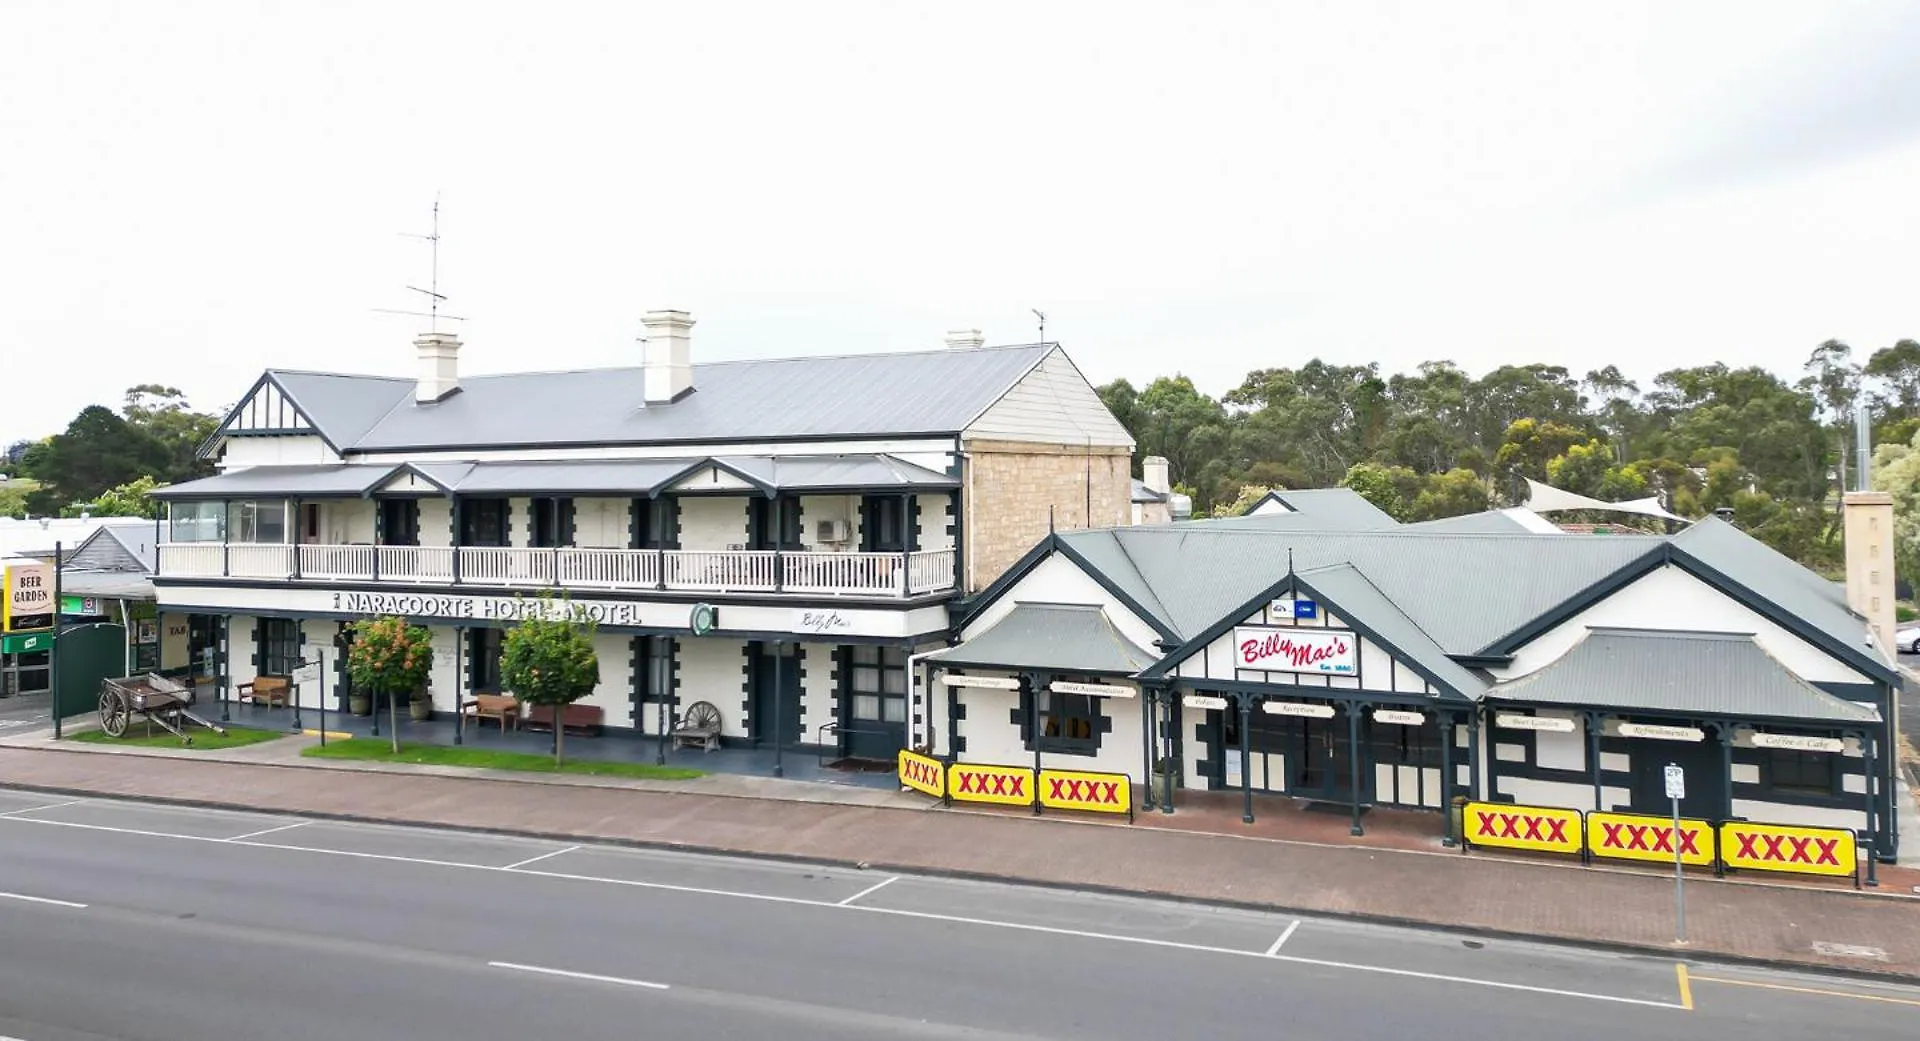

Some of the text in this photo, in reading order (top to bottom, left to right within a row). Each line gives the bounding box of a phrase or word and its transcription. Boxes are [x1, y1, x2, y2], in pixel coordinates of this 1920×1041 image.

[20, 576, 42, 588] BEER
[14, 590, 48, 602] GARDEN
[346, 592, 473, 617] NARACOORTE
[169, 625, 186, 636] TAB
[1240, 633, 1348, 667] Billy Mac's
[1766, 736, 1794, 747] Coffee
[903, 757, 938, 788] XXXX
[958, 772, 1025, 797] XXXX
[1049, 778, 1119, 804] XXXX
[1476, 811, 1568, 843] XXXX
[1602, 822, 1701, 856] XXXX
[1735, 832, 1841, 866] XXXX
